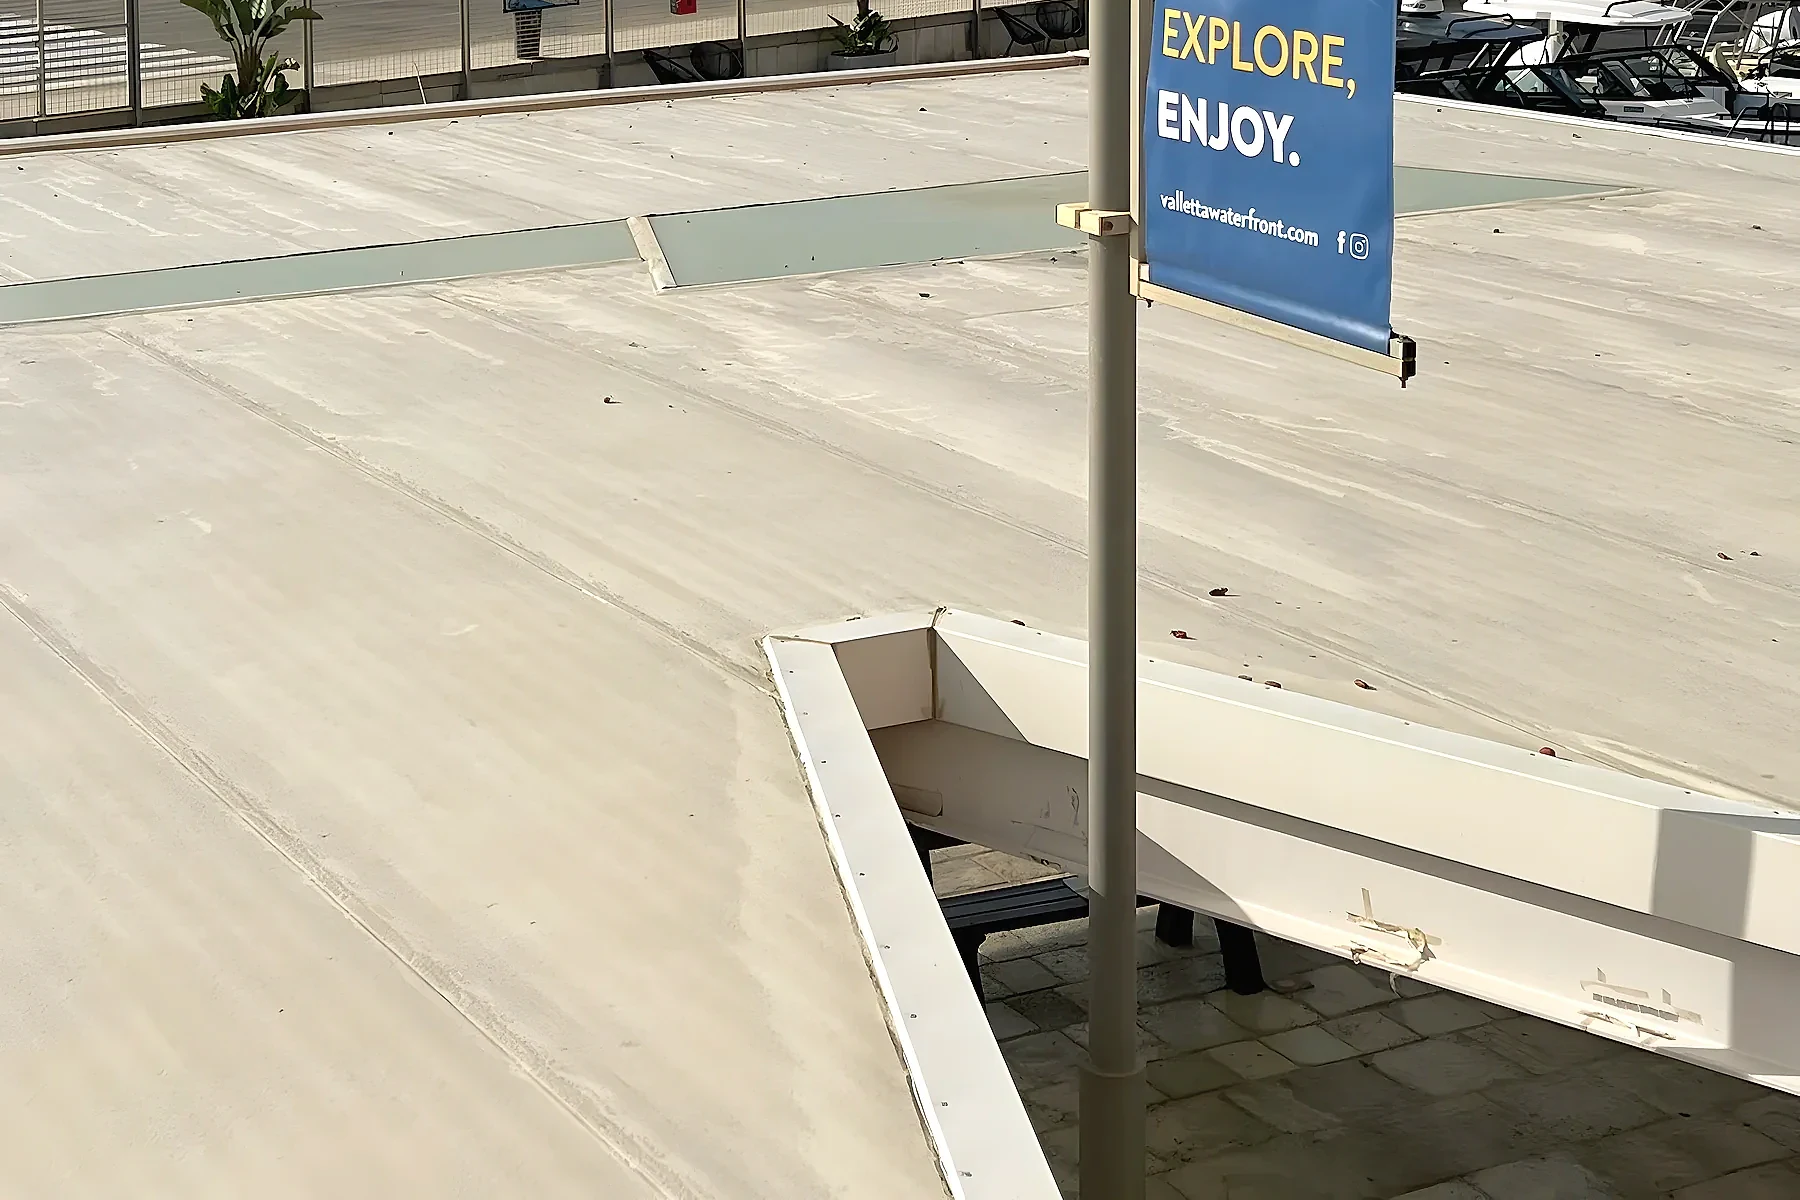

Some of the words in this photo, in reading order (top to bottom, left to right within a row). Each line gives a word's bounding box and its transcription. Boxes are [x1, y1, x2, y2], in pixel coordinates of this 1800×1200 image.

[1161, 8, 1357, 99] EXPLORE,
[1157, 89, 1301, 167] ENJOY.
[1160, 189, 1319, 247] vallettawaterfront.com
